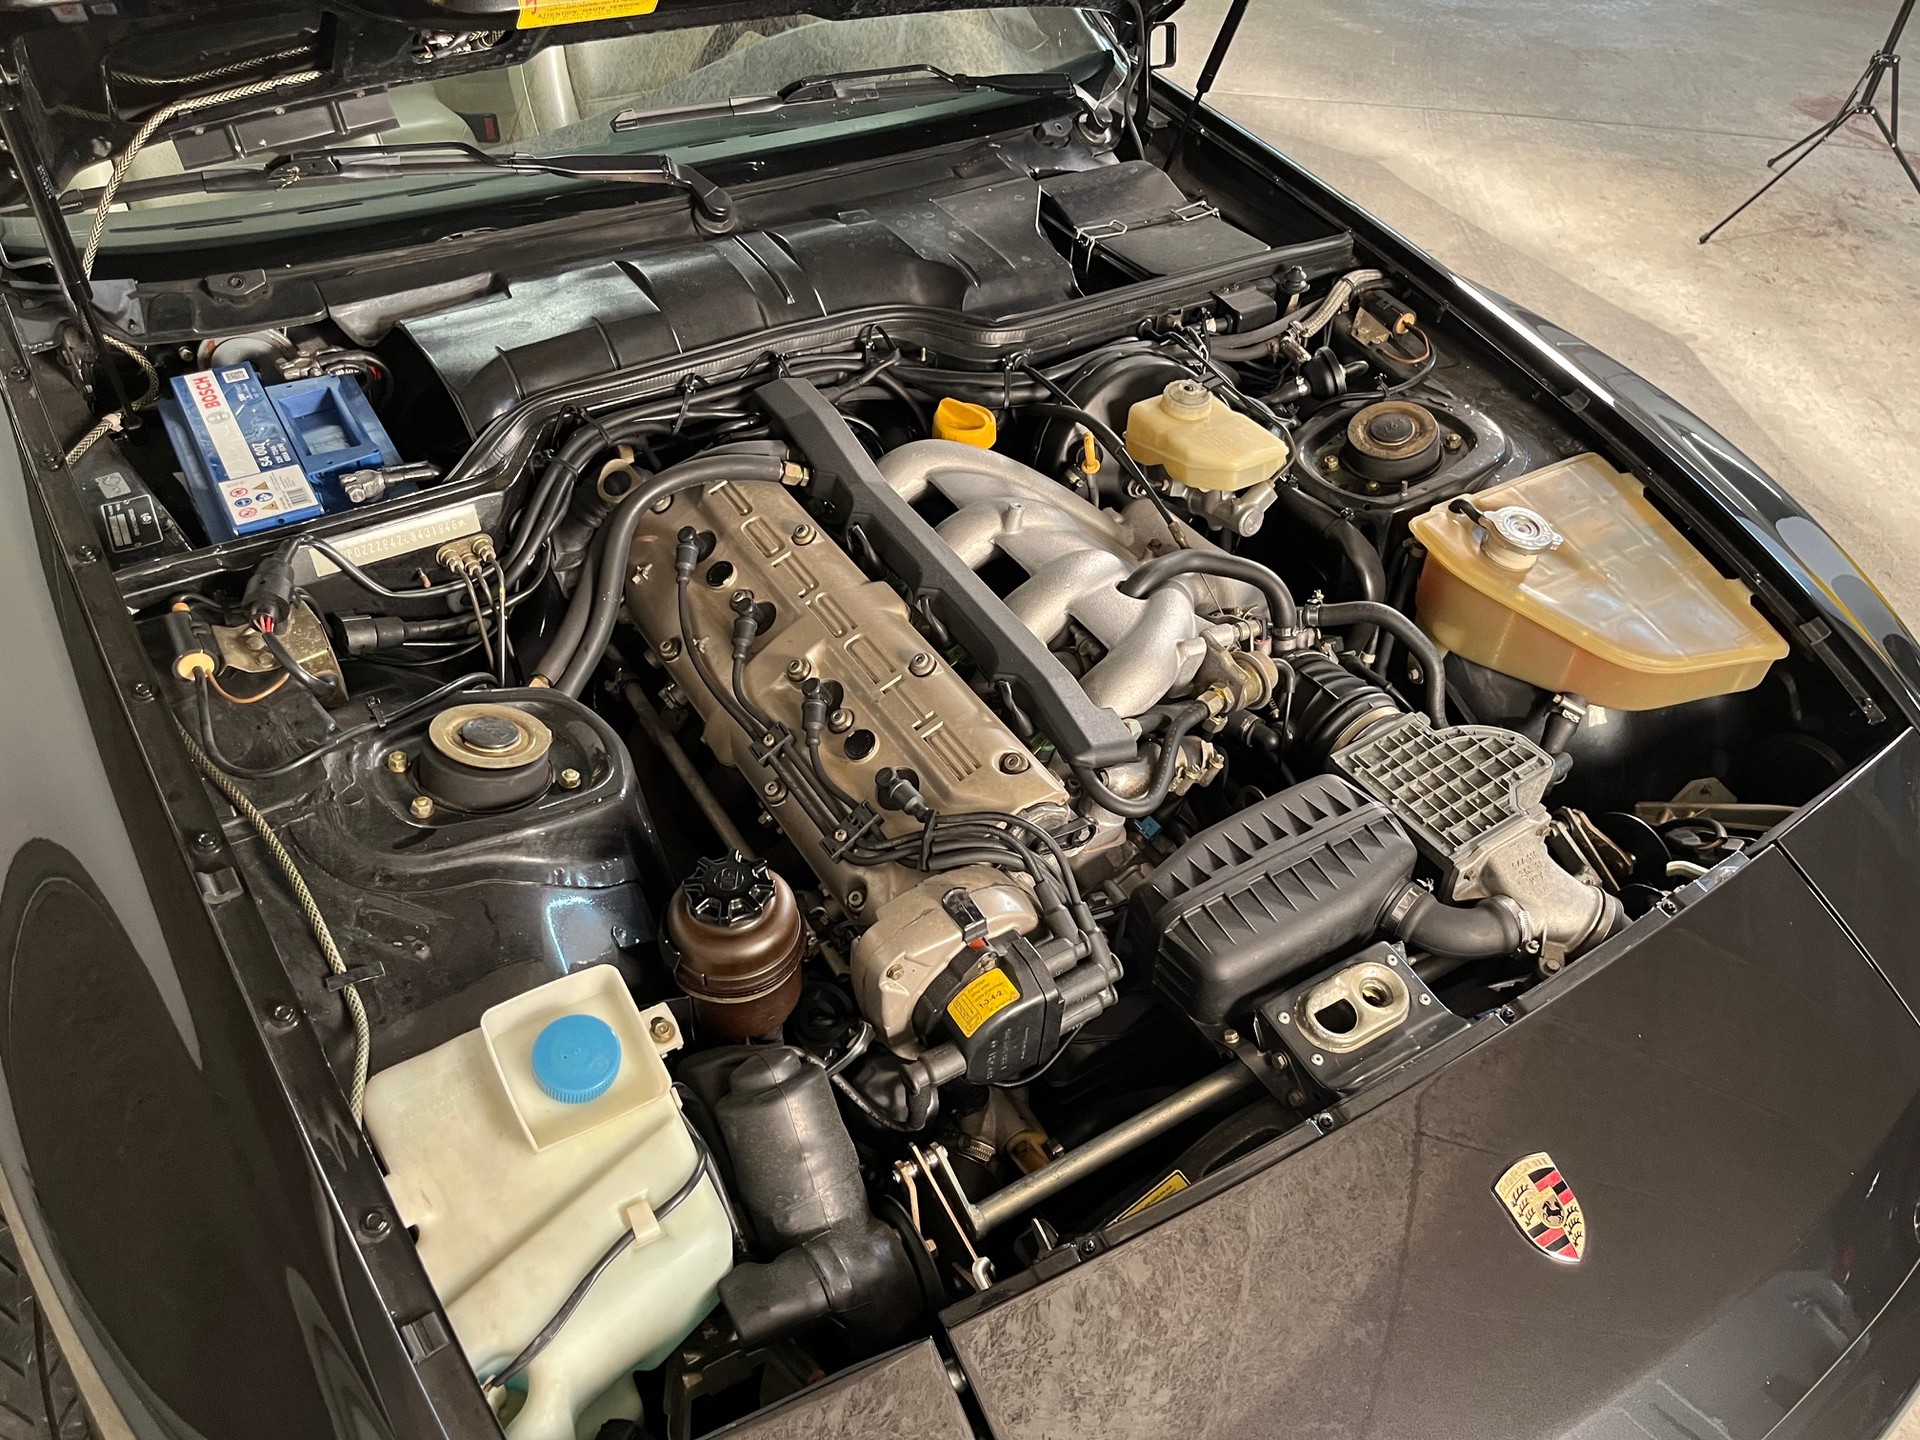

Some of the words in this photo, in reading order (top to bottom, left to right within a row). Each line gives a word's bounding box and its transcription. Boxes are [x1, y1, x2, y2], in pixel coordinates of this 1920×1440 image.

[193, 376, 222, 409] BOSCH
[258, 455, 273, 467] S4
[708, 480, 983, 782] PORSCHE
[979, 990, 1003, 1009] 1-3-4-2
